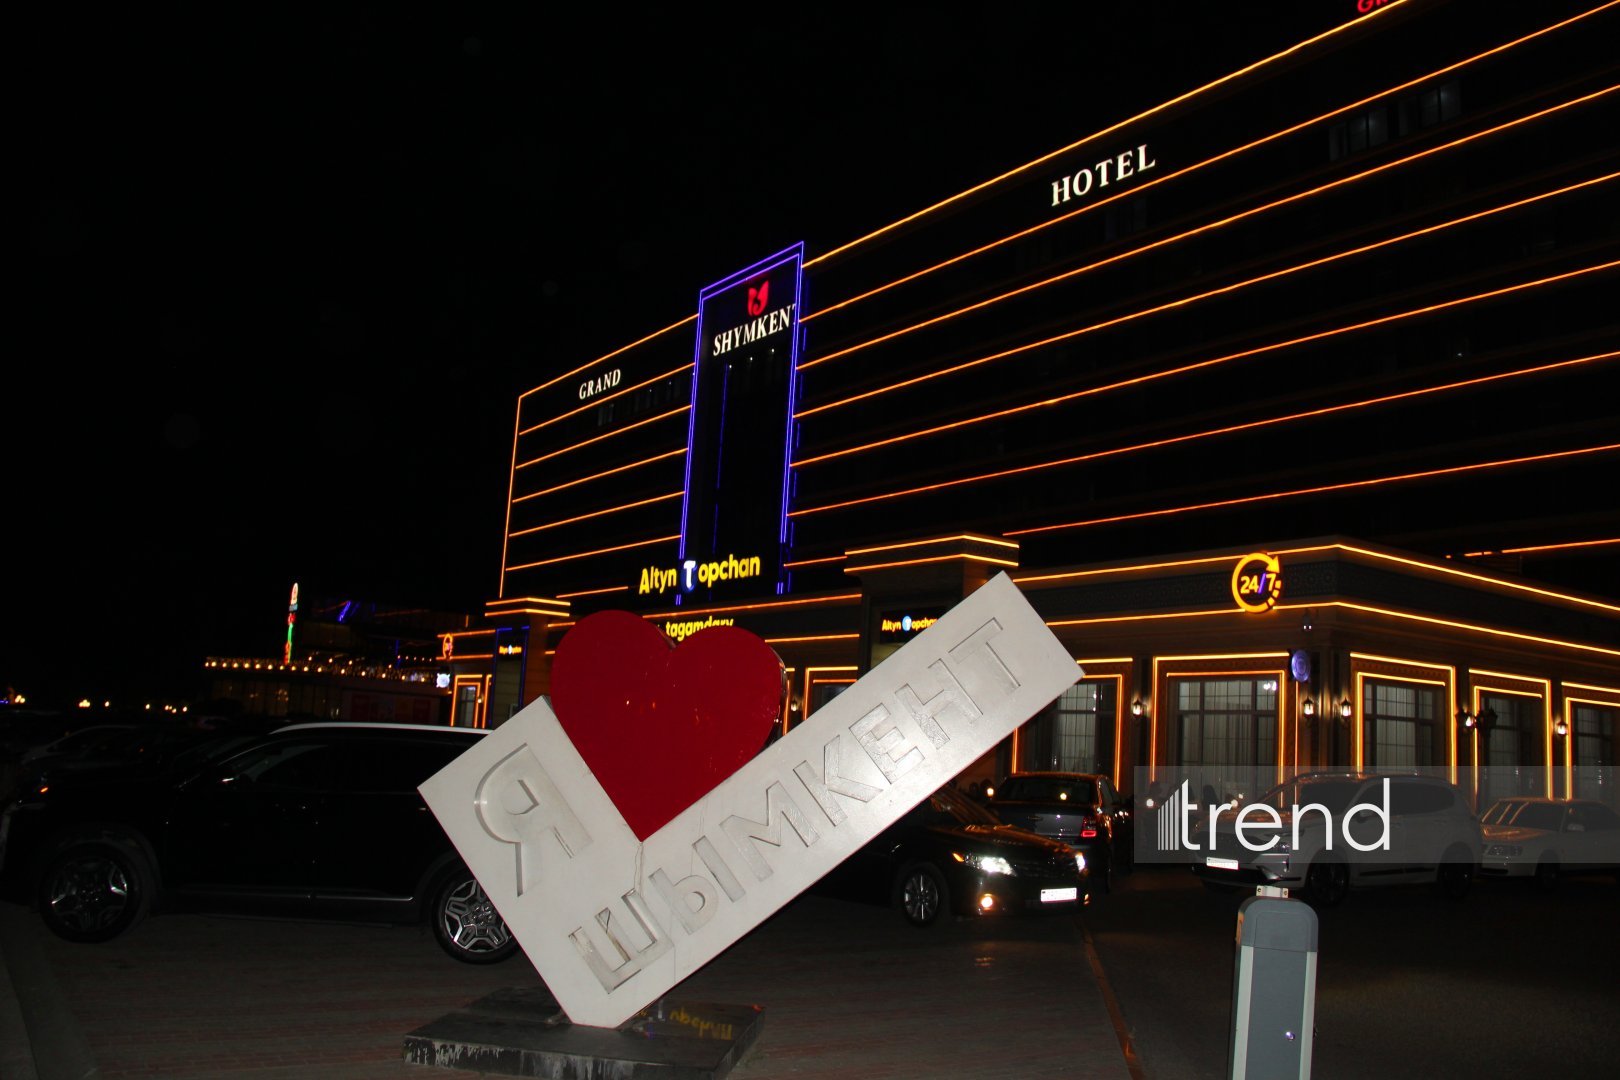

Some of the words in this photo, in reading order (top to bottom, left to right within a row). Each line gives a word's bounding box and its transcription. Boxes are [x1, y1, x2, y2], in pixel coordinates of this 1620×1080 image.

[1051, 144, 1156, 207] HOTEL
[579, 368, 621, 400] GRAND
[639, 566, 677, 595] Altyn
[683, 554, 760, 589] Topchan
[1240, 572, 1277, 594] 24/7
[881, 619, 902, 632] Altyn
[474, 742, 594, 898] Я
[567, 616, 1022, 995] ШЫМКЕНТ
